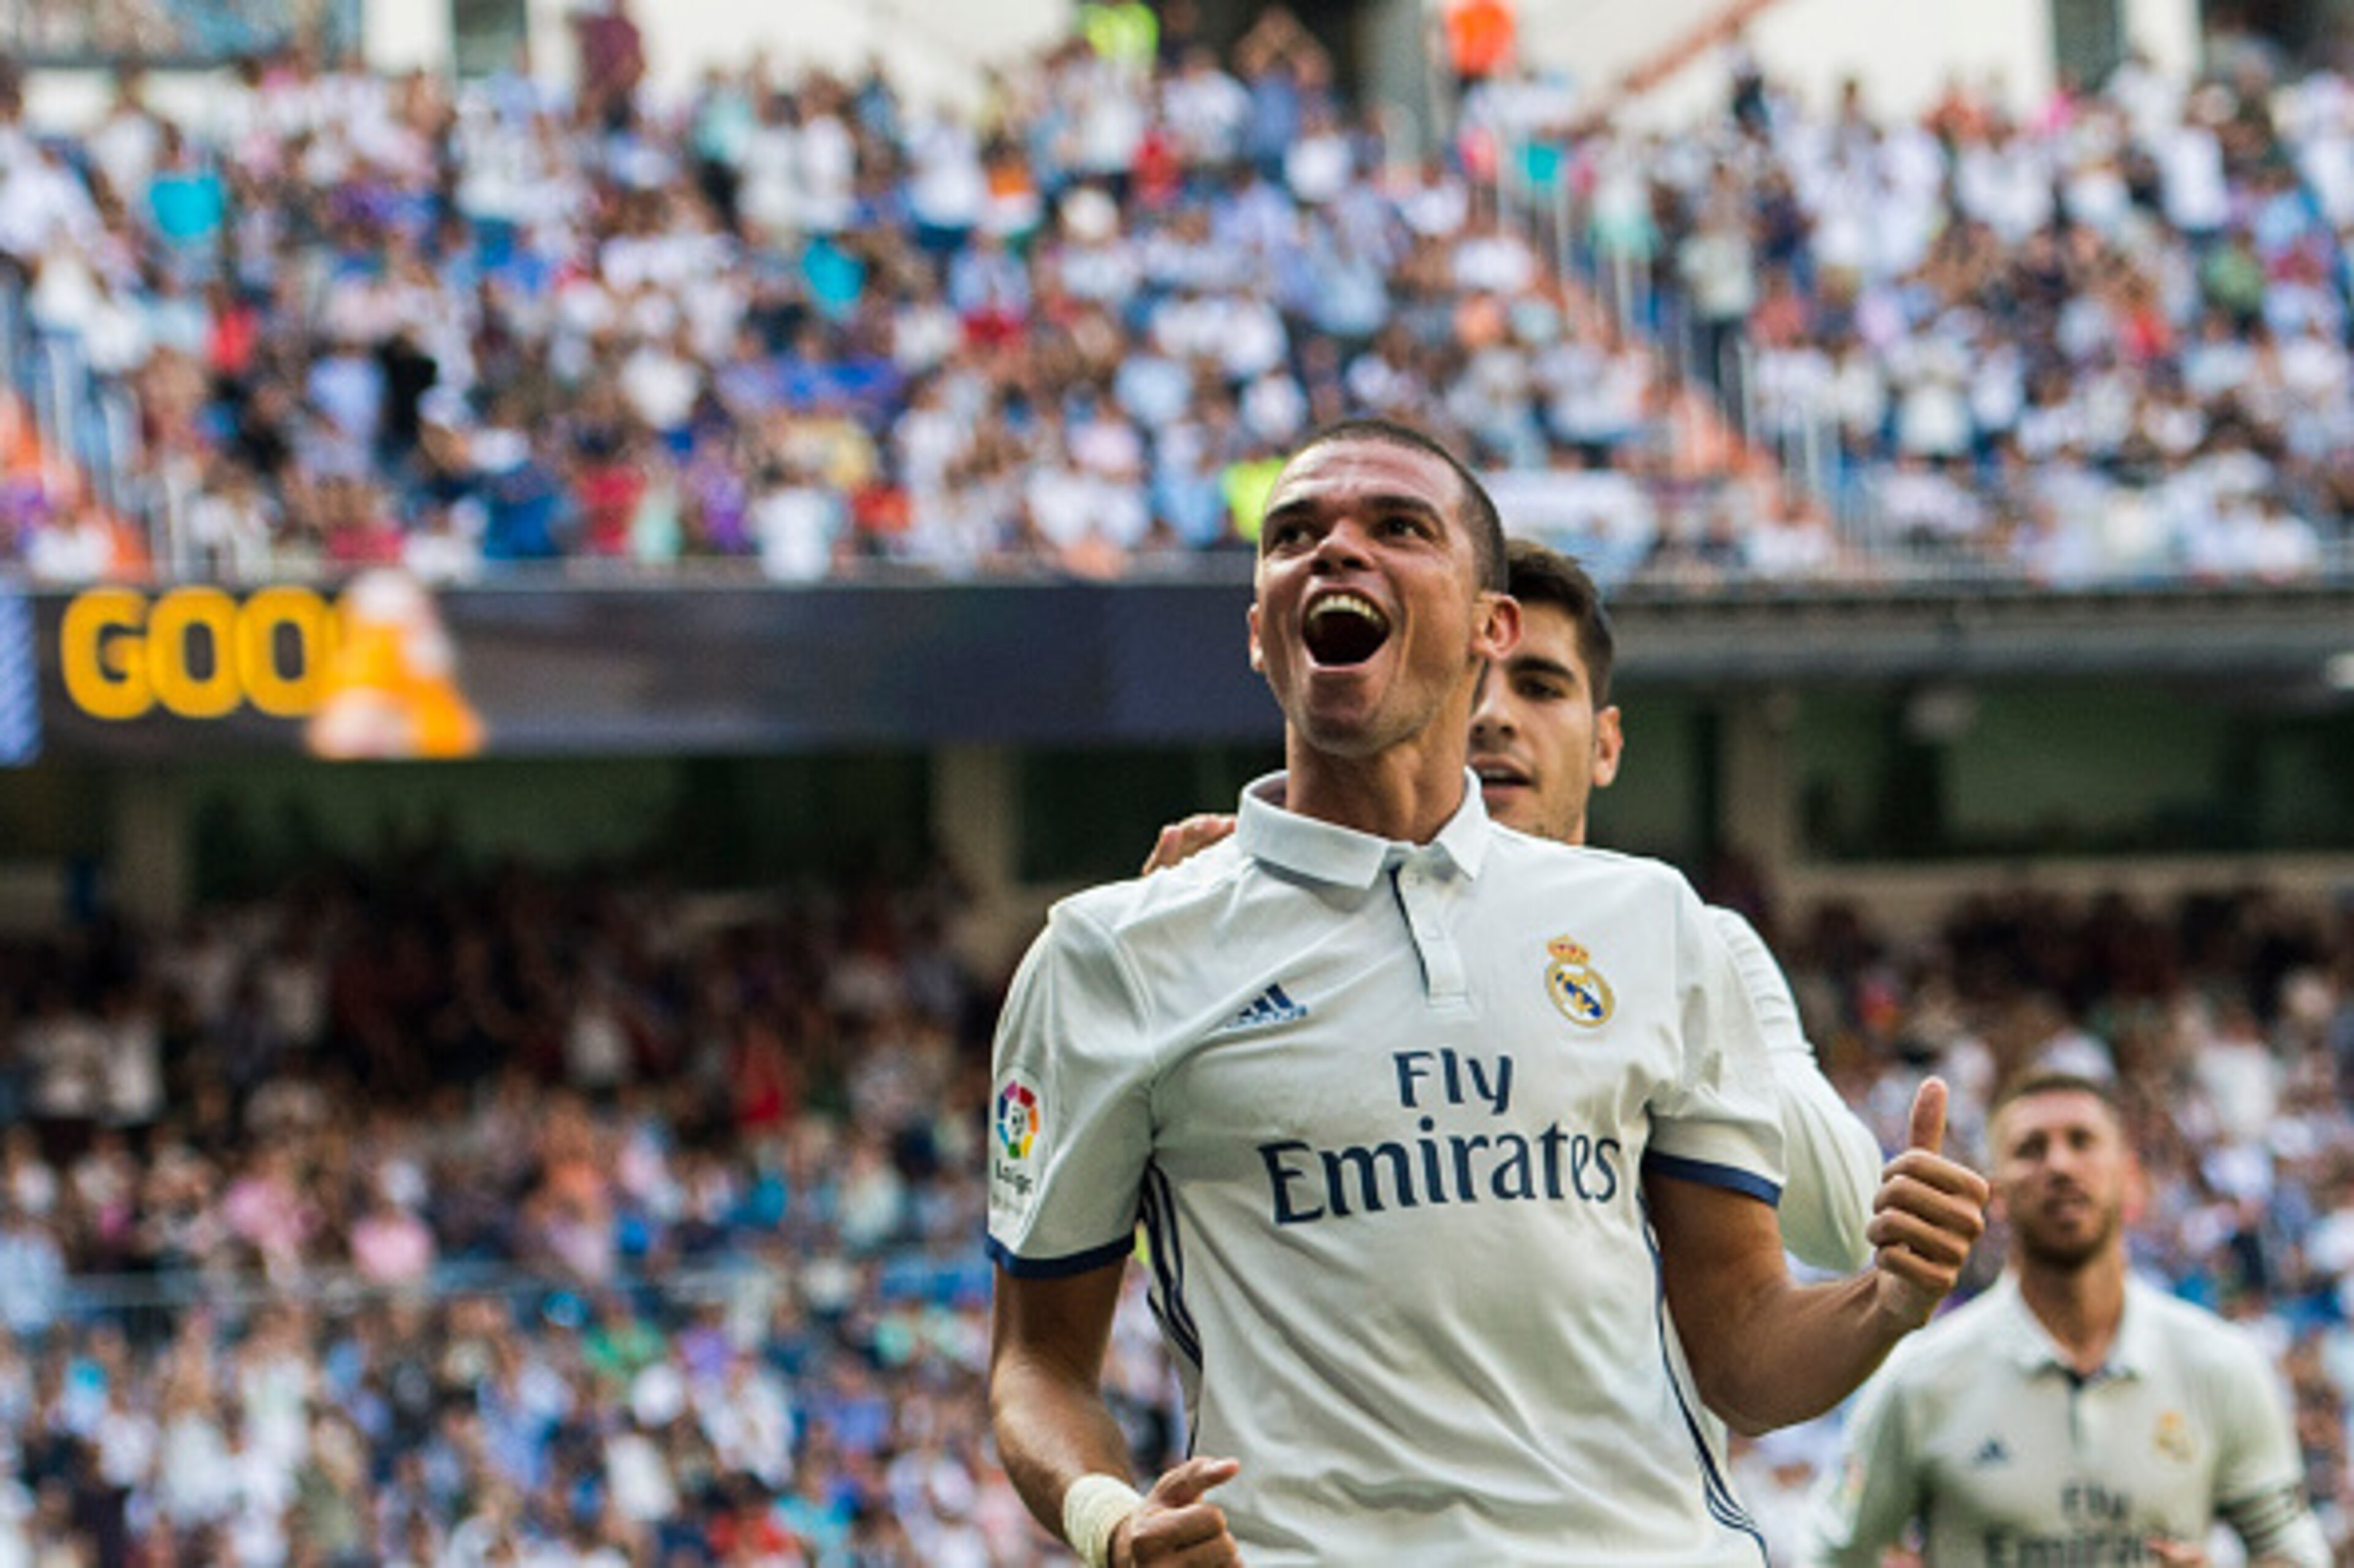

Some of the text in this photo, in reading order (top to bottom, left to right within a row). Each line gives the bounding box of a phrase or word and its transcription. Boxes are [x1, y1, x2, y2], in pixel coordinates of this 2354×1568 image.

[63, 585, 340, 719] GOO
[1393, 1048, 1512, 1114] Fly
[1257, 1116, 1620, 1225] Emirates
